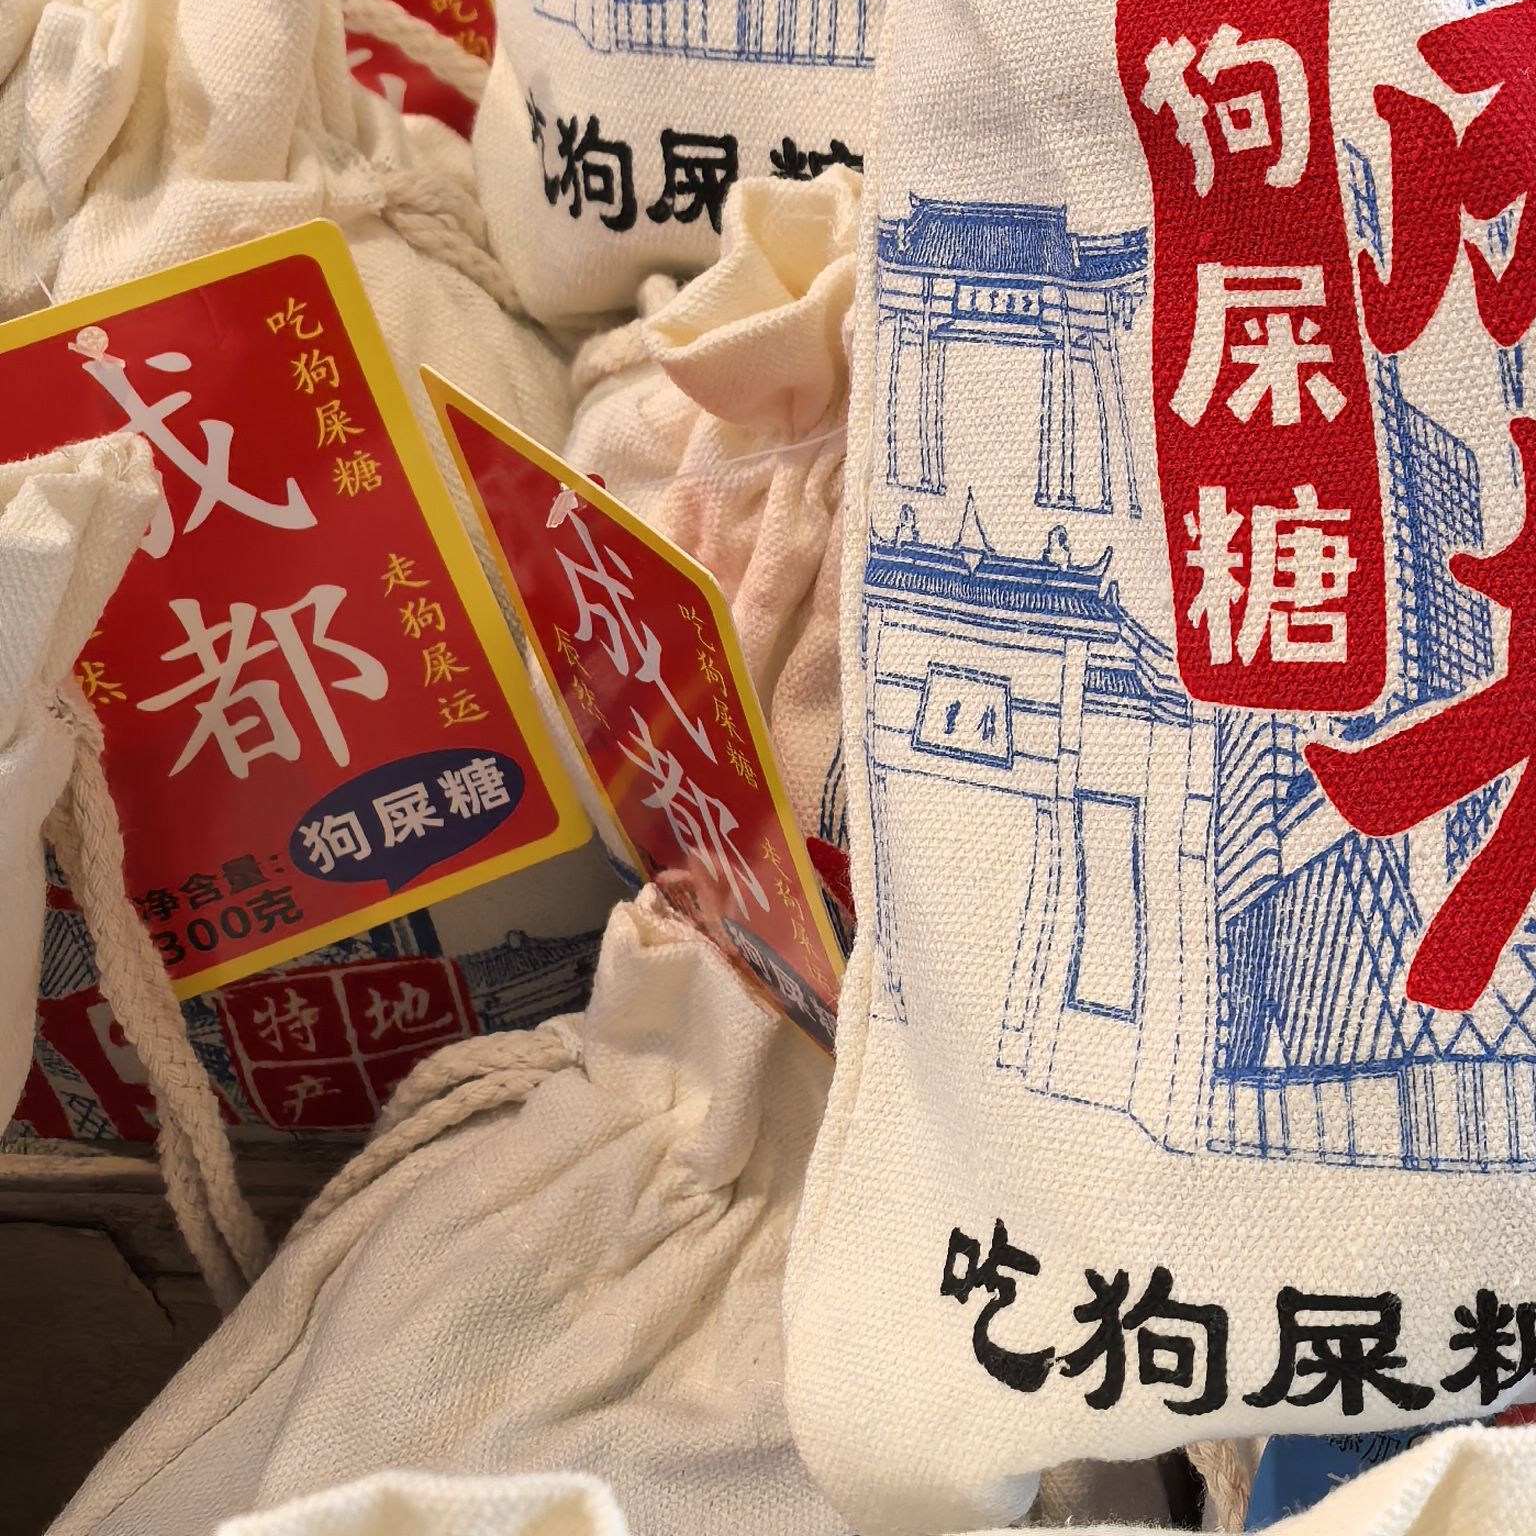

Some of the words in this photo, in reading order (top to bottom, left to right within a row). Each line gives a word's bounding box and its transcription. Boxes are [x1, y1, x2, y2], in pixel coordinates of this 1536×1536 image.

[266, 297, 384, 499] 吃狗屎糖
[1140, 20, 1361, 670] 狗屎糖
[80, 350, 390, 781] 成都
[381, 552, 489, 730] 走狗屎运
[554, 509, 770, 922] 成都
[299, 756, 514, 876] 狗屎糖
